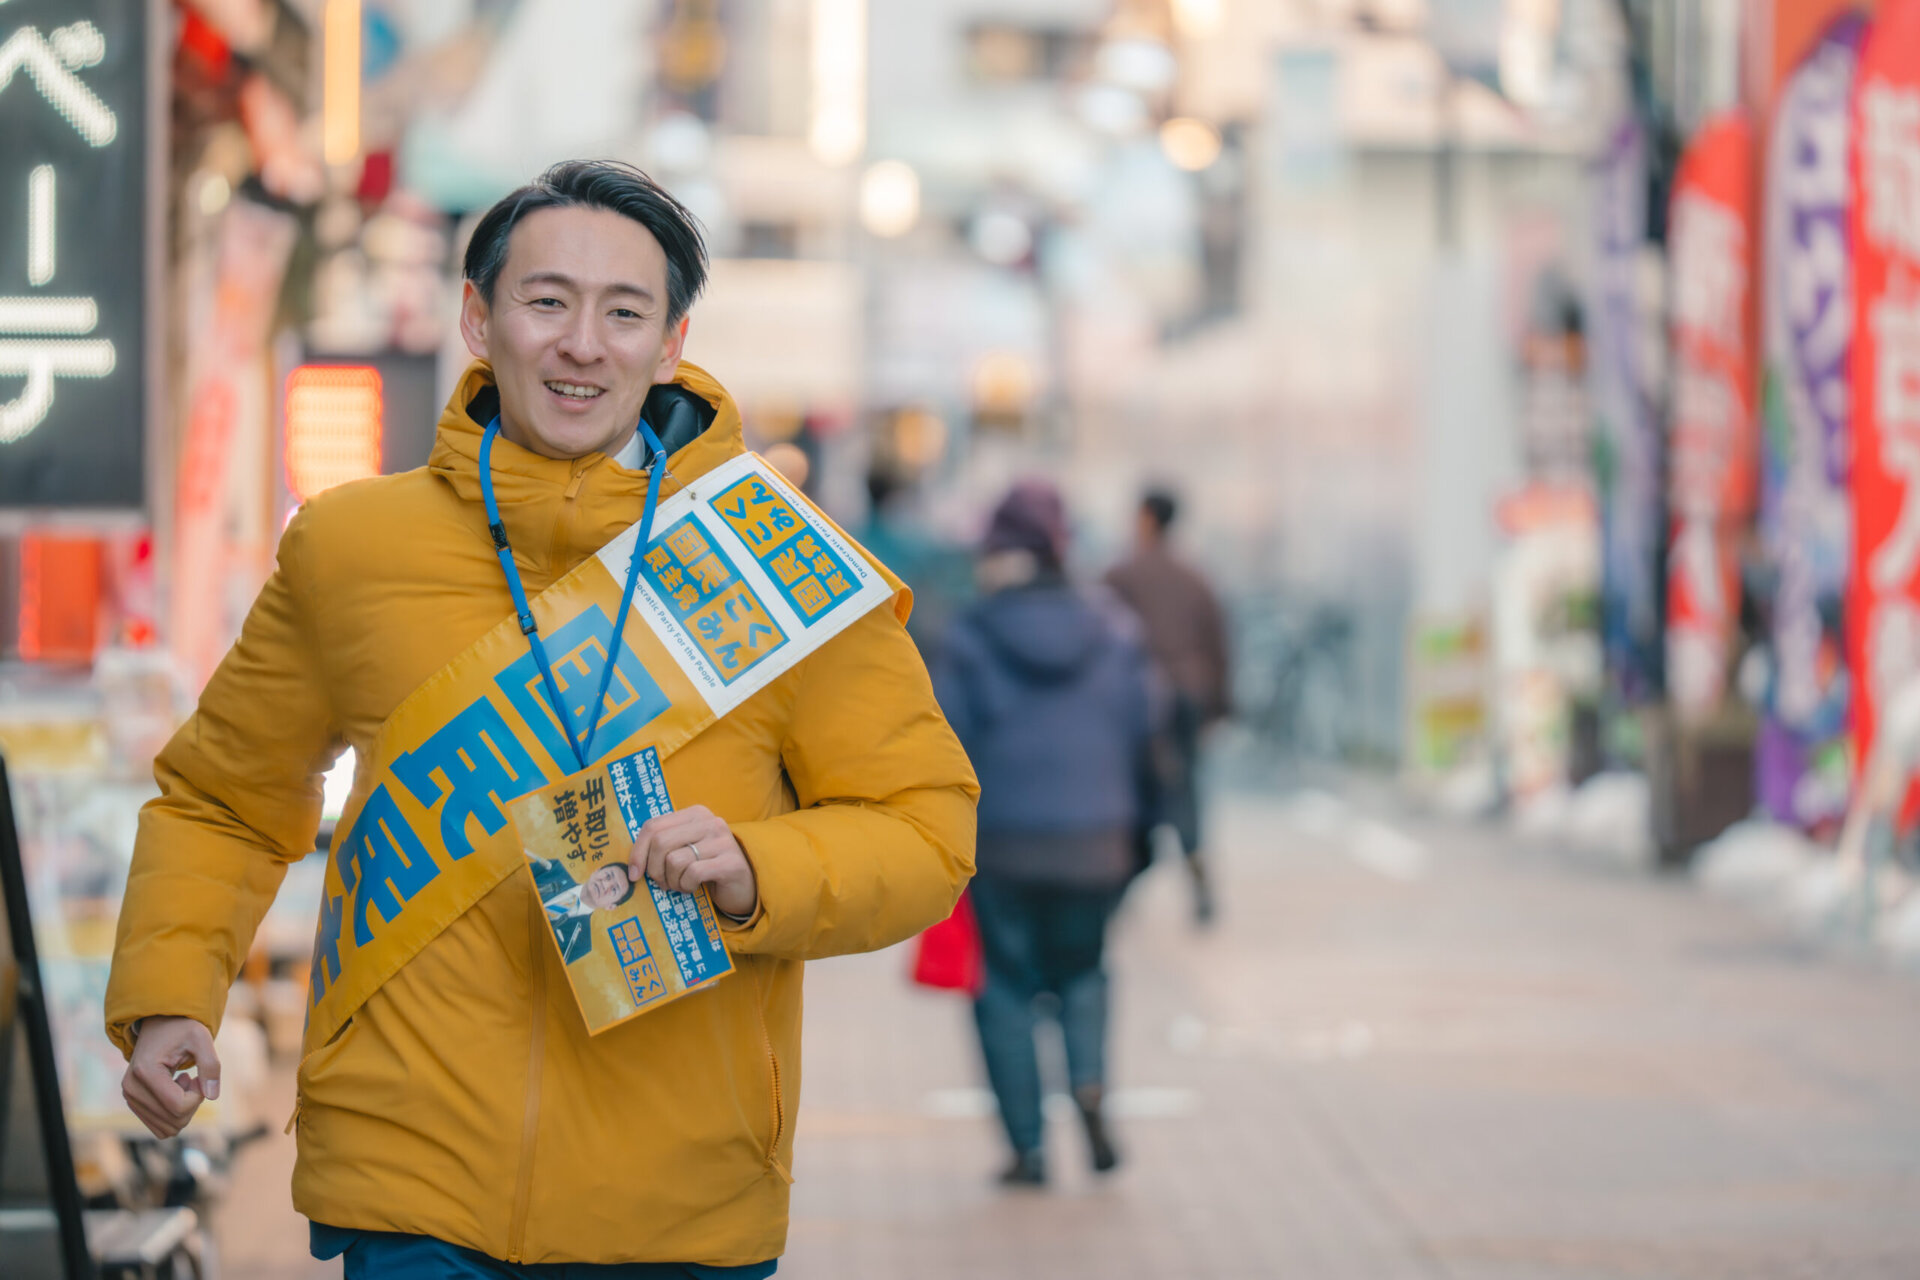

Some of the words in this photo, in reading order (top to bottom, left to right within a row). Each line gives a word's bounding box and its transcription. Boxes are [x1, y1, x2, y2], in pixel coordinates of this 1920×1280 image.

[723, 495, 773, 548] こく
[743, 478, 796, 534] みん
[787, 494, 799, 507] the
[799, 506, 812, 519] For
[811, 518, 830, 538] Party
[664, 520, 732, 596] 国民
[720, 589, 774, 649] こく
[768, 546, 832, 617] 国民
[794, 533, 851, 597] 民主党
[830, 537, 867, 578] Democratic
[623, 565, 660, 612] Docratic
[655, 610, 676, 634] Party
[673, 632, 687, 647] For
[683, 645, 697, 661] the
[693, 659, 718, 689] People
[642, 542, 702, 612] 民主党
[693, 608, 749, 671] みん
[631, 753, 653, 795] 神奈川県
[643, 749, 672, 815] もっと手取りを
[304, 603, 672, 1035] 国民民主
[578, 775, 607, 863] 手取りを
[667, 888, 702, 962] 上郡・足柄下郡
[628, 966, 648, 999] みん
[641, 961, 660, 991] こく
